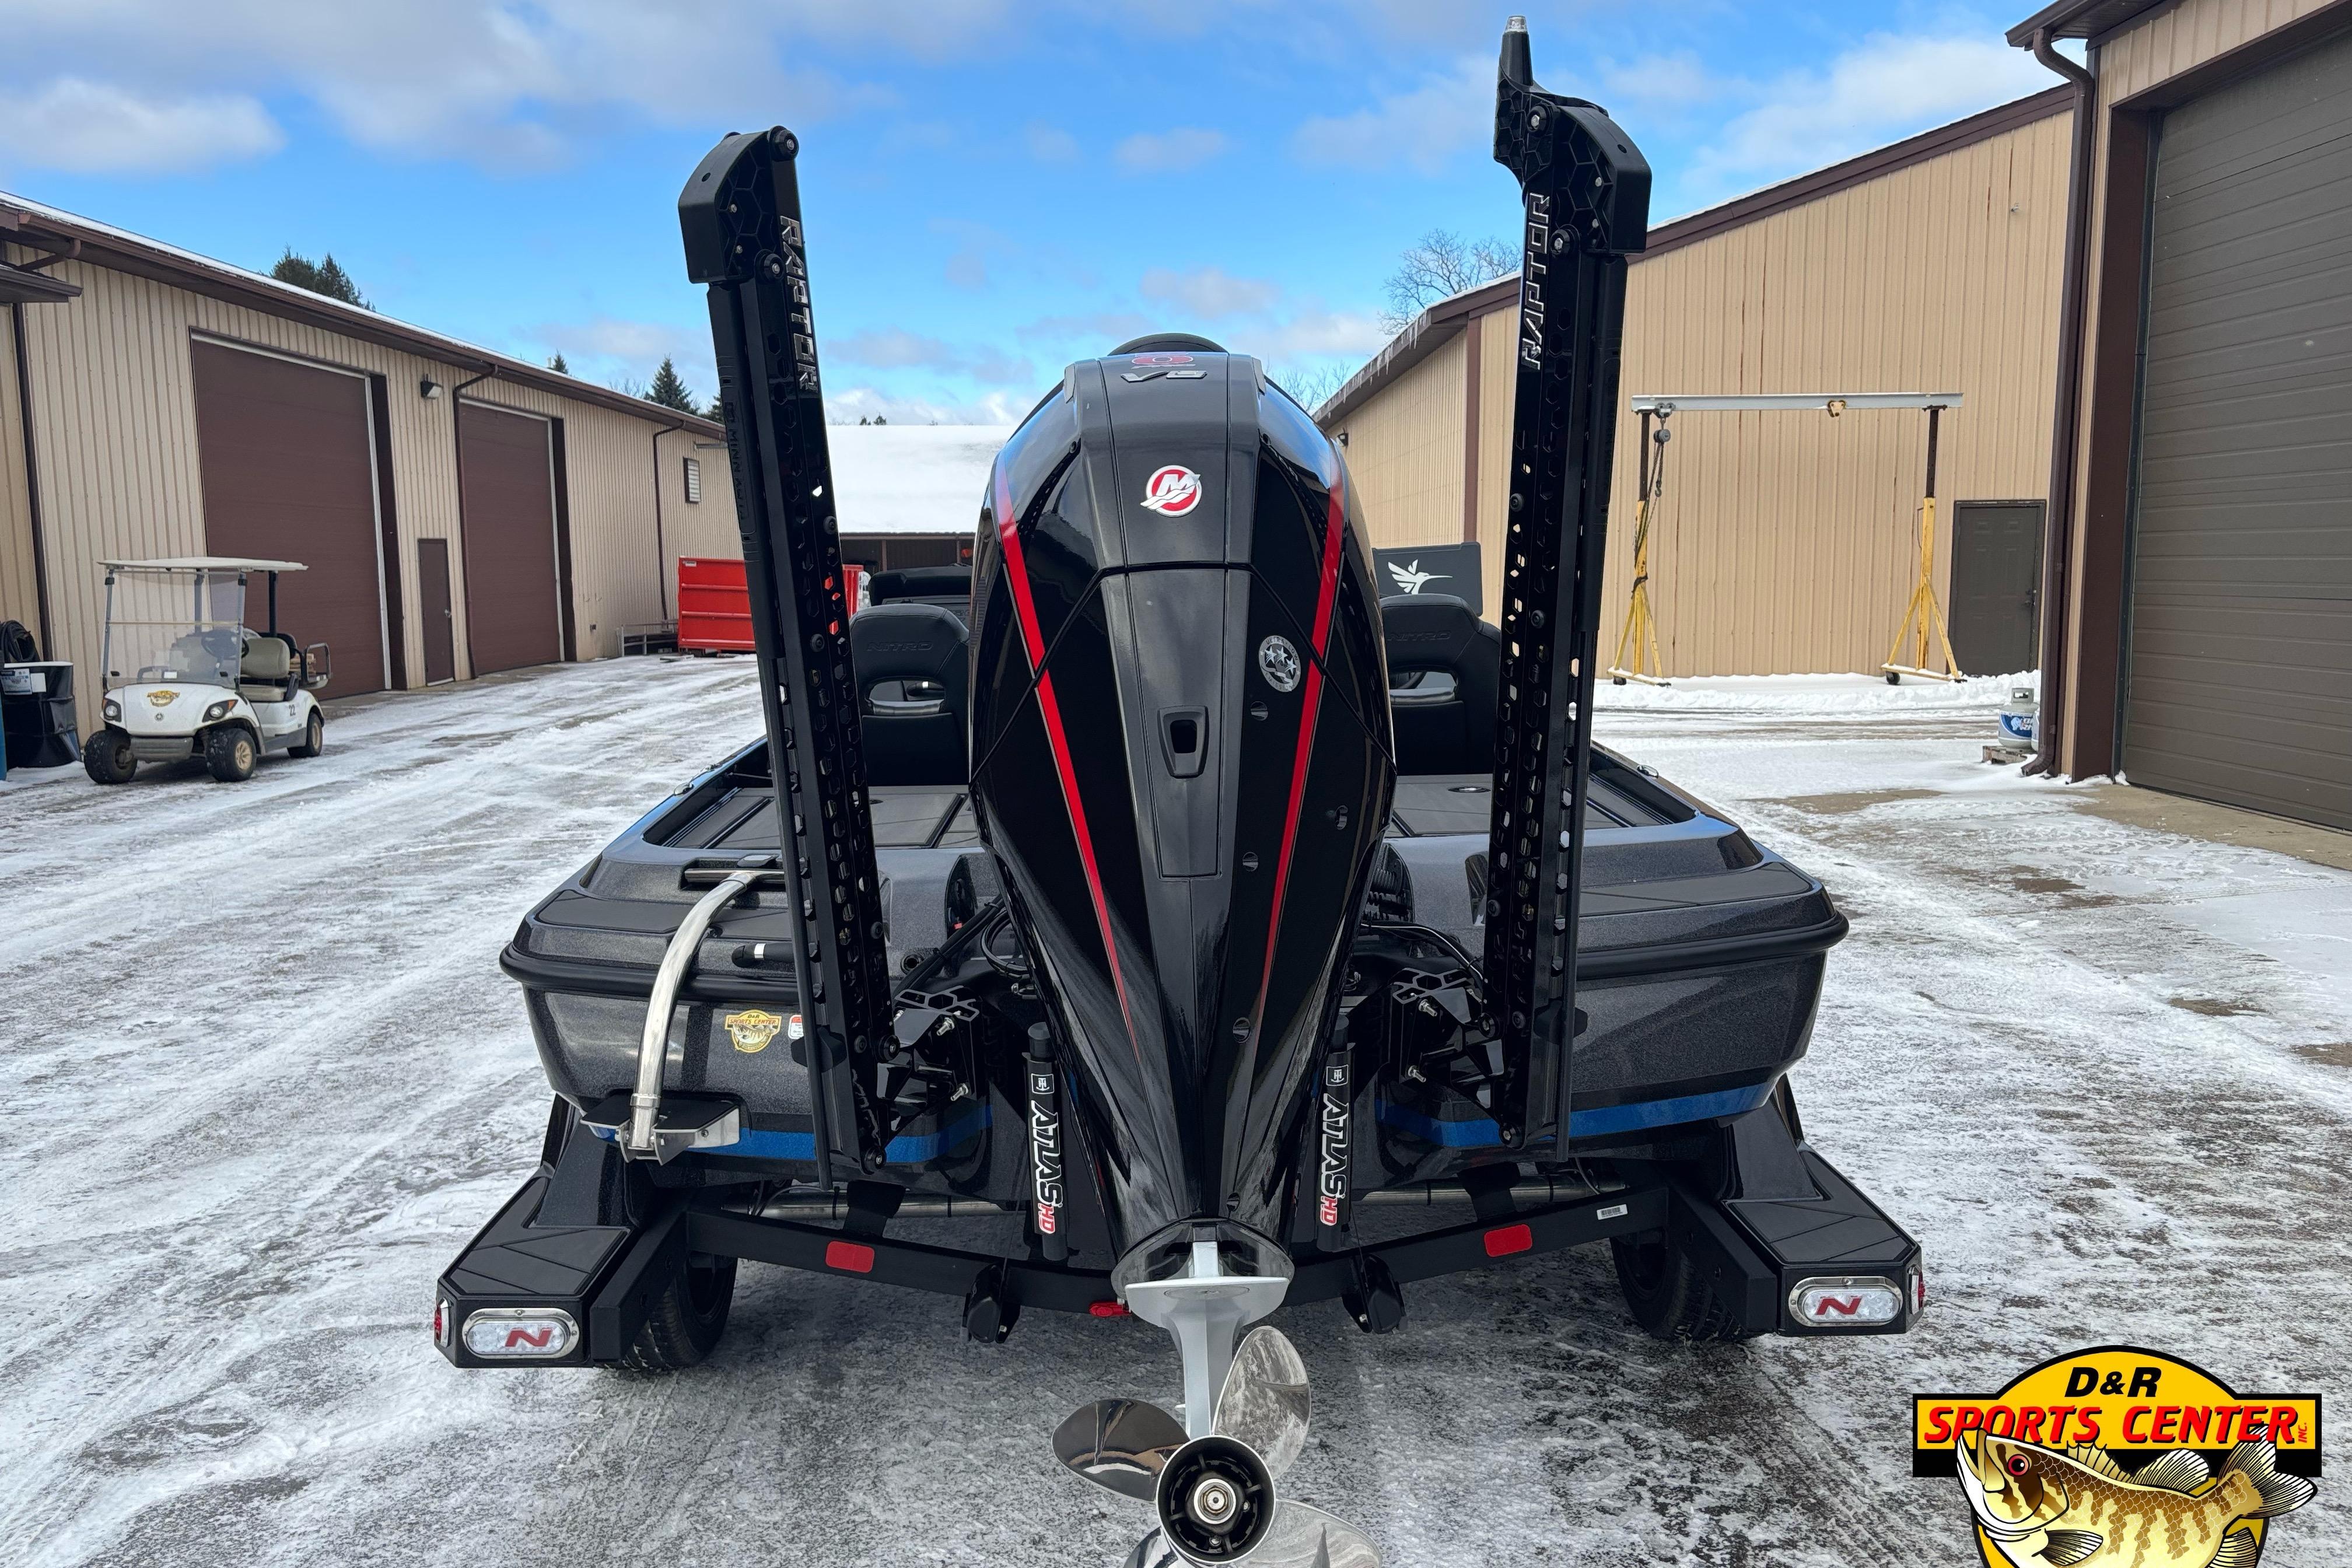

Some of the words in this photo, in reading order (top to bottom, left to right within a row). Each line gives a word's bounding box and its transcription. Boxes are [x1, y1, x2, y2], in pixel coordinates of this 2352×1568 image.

[780, 215, 817, 393] RAPTOR
[1521, 193, 1549, 370] RAPTOR
[867, 641, 934, 652] NITRO
[289, 704, 296, 716] 22
[1031, 1100, 1063, 1208] ATLAS
[1321, 1093, 1349, 1199] ATLAS
[1038, 1202, 1056, 1234] HD
[1320, 1196, 1338, 1226] HD
